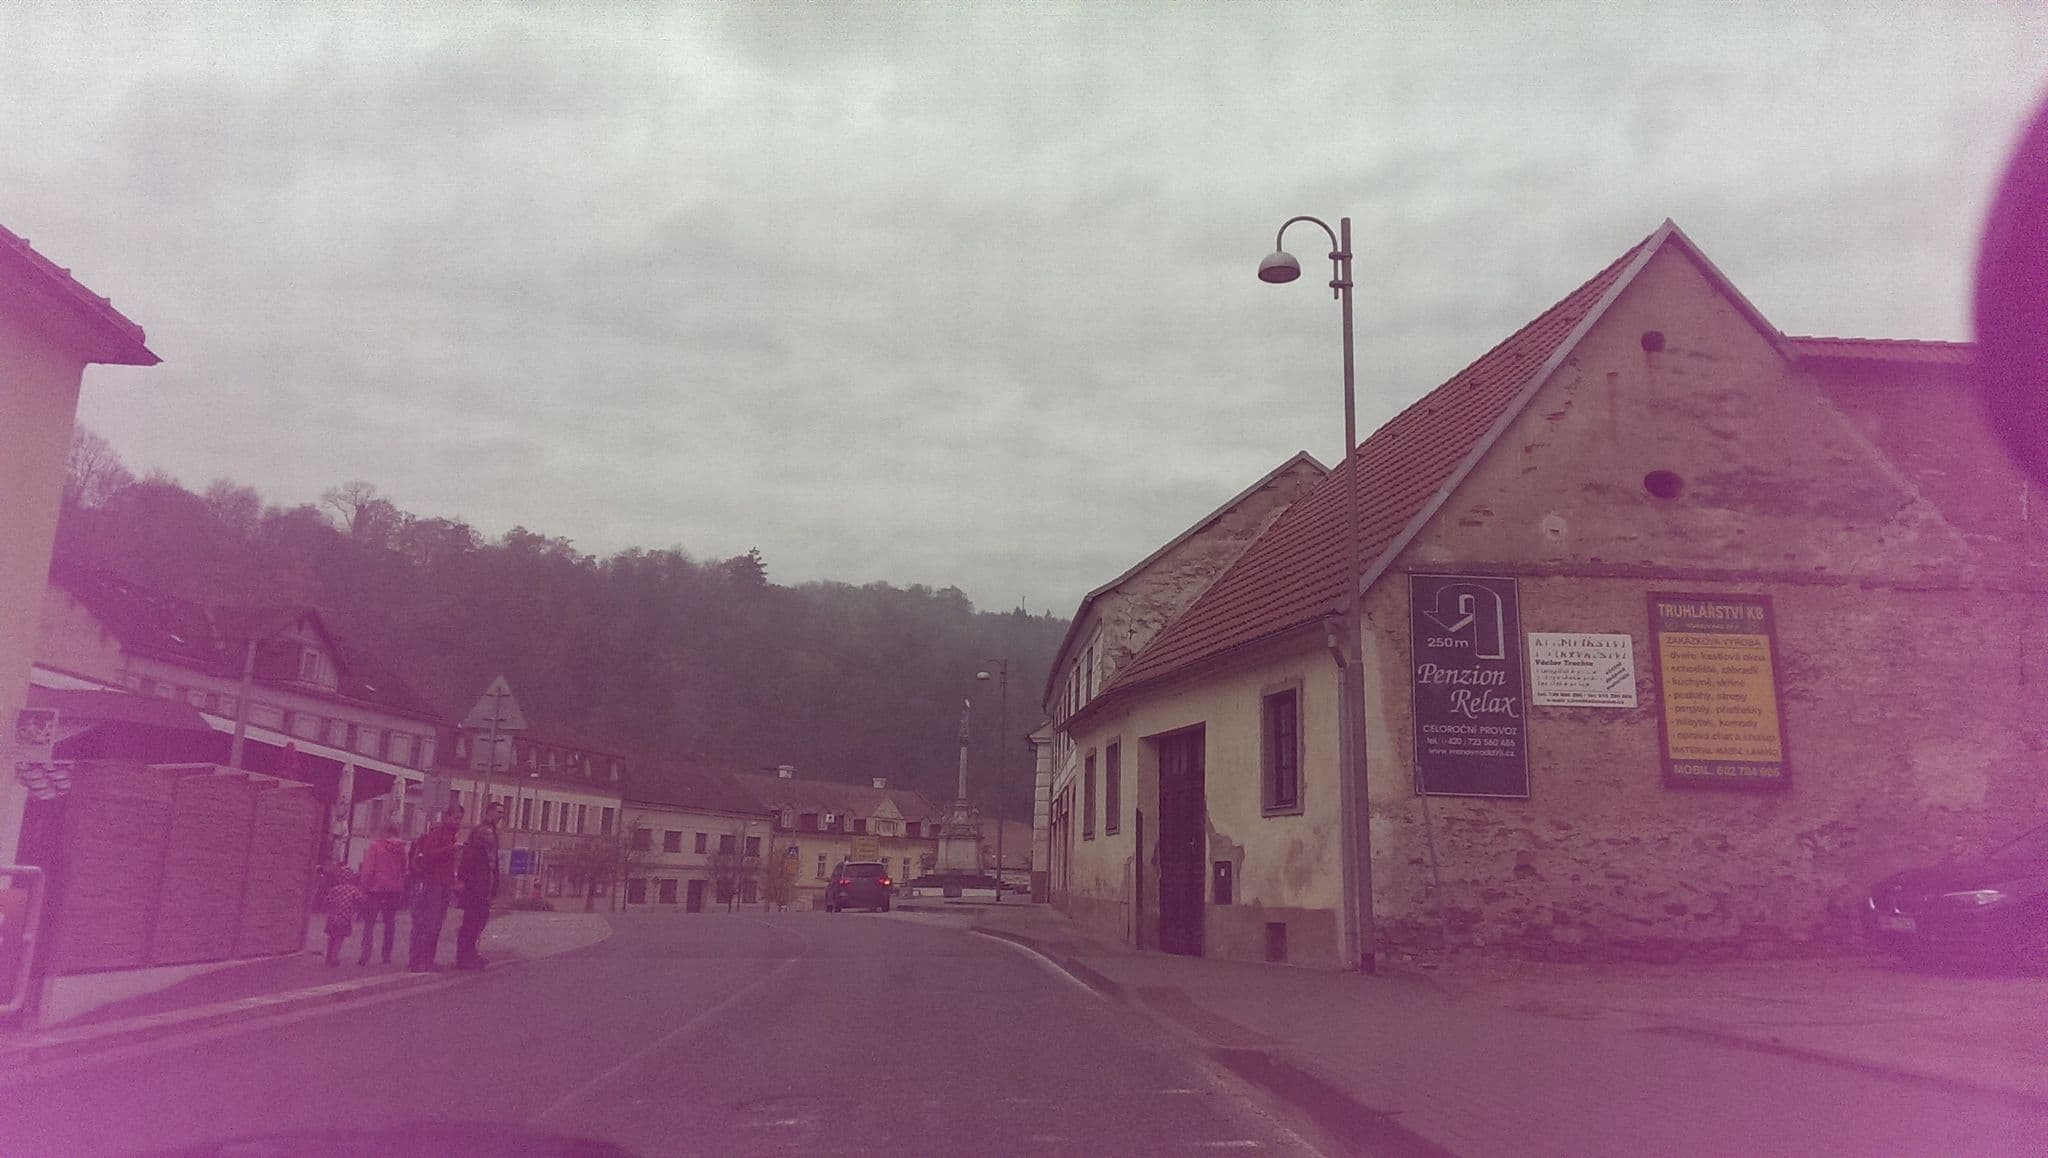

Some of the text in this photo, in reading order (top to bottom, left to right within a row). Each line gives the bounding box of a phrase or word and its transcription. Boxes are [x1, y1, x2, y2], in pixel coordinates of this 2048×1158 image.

[1418, 664, 1506, 686] Penzion
[1450, 689, 1520, 719] Relax
[1424, 724, 1518, 735] CELOROČNÍ PROVOZ
